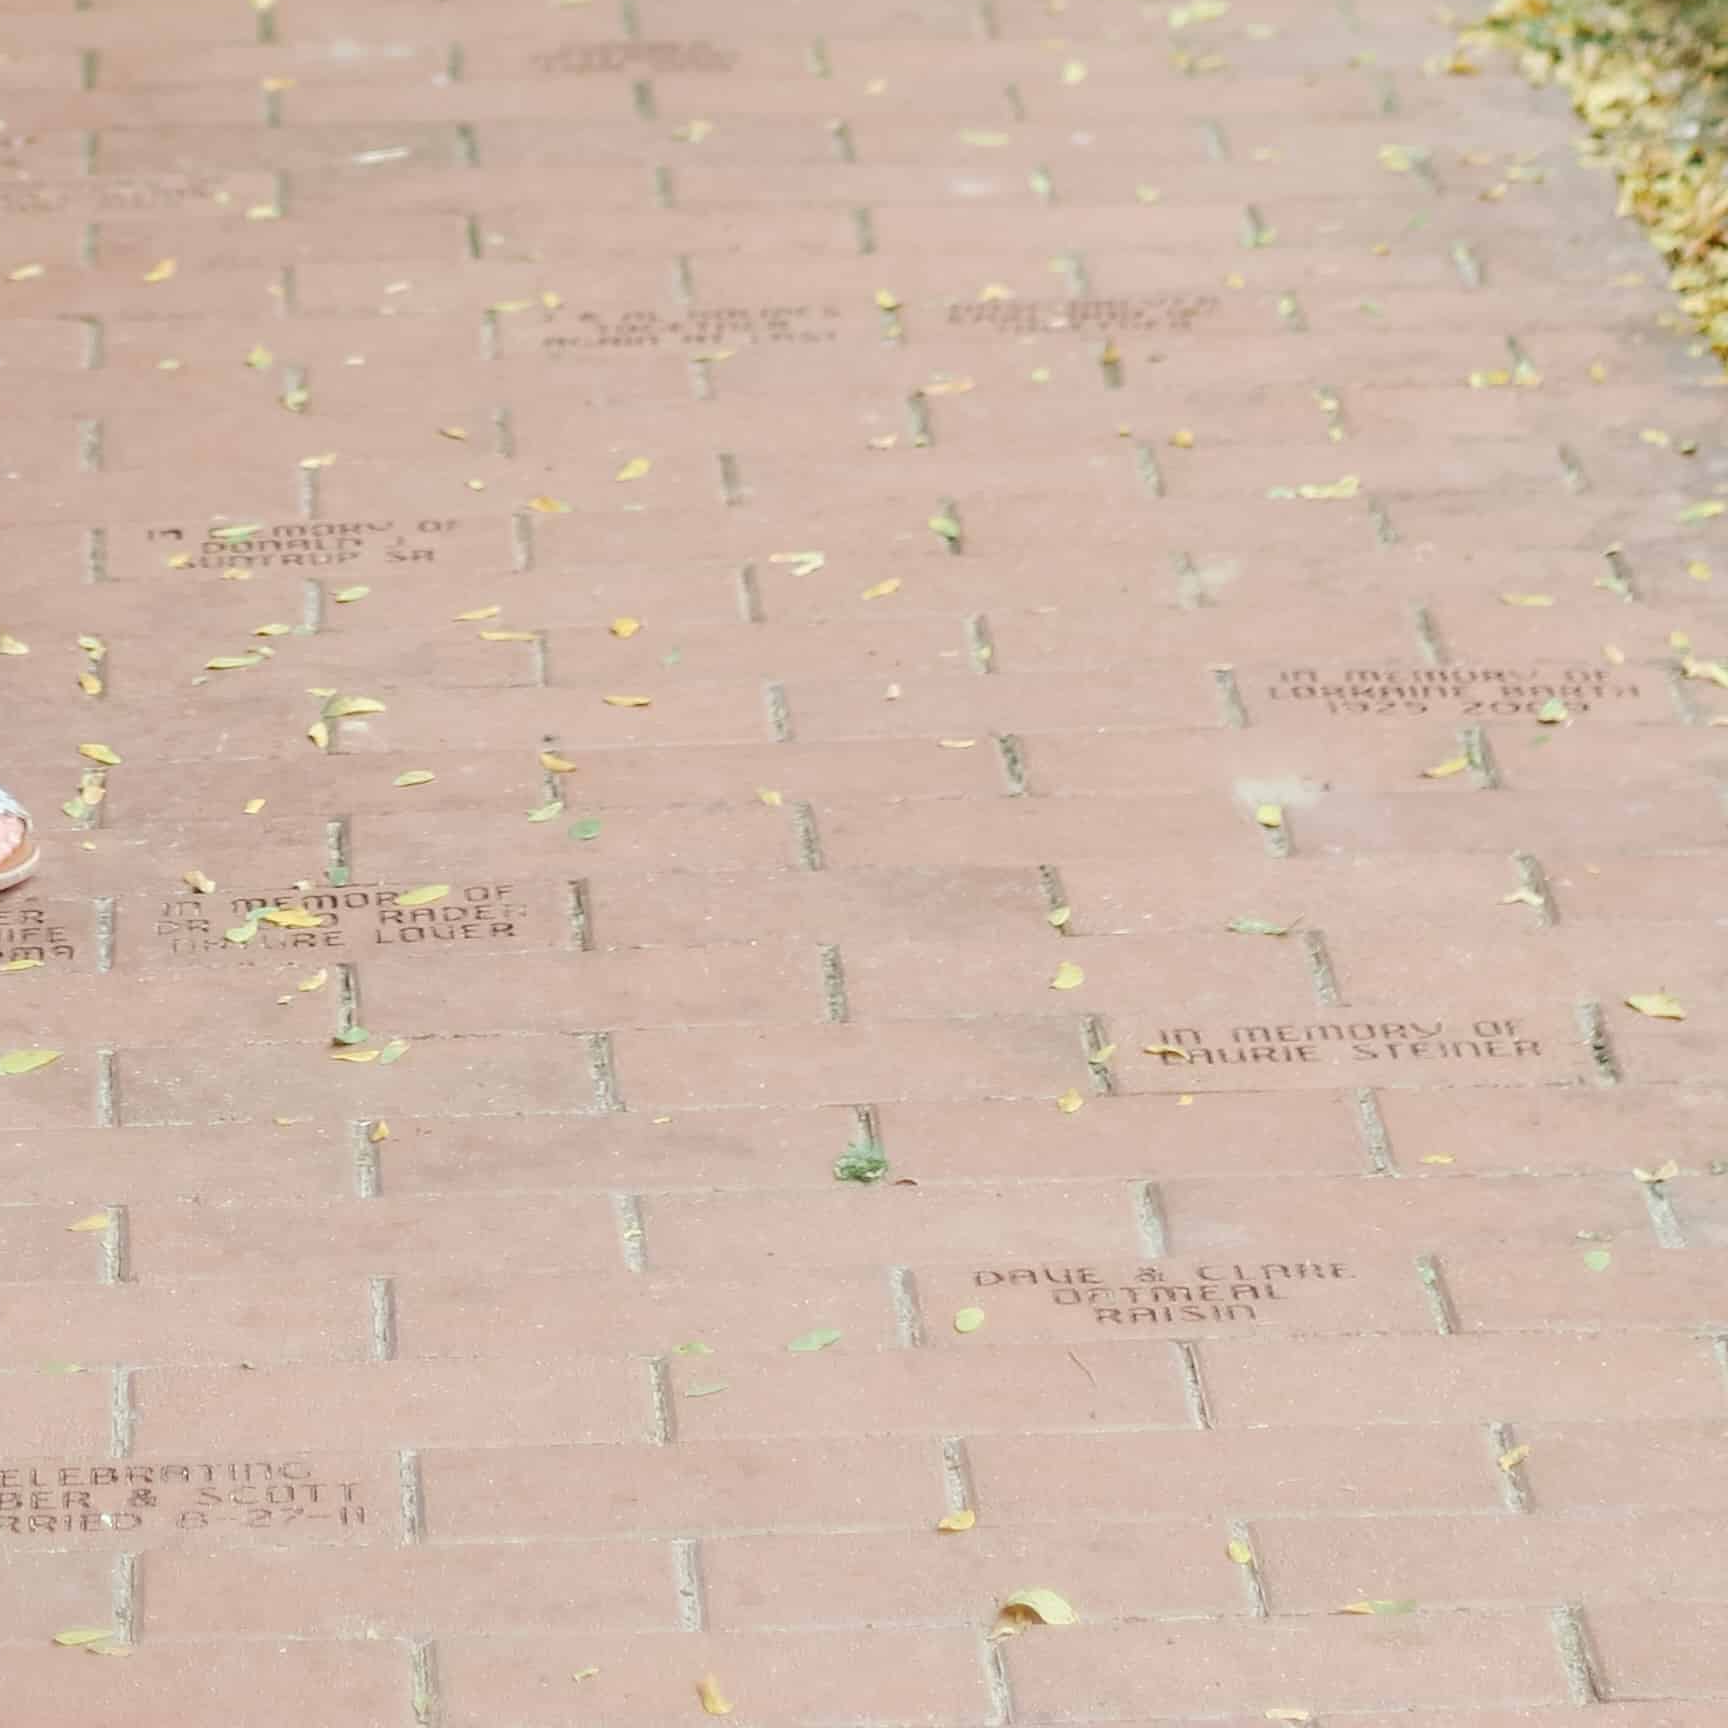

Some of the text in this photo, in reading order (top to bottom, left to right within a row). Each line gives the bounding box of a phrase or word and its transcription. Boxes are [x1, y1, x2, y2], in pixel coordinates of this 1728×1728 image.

[208, 520, 394, 539] MORY
[201, 538, 363, 554] DONALD
[161, 885, 513, 916] IN MEMOR OF
[157, 918, 209, 935] DR
[378, 904, 527, 924] RADER
[173, 930, 345, 953] NAURE
[1159, 1018, 1525, 1045] IN MEMORY OF
[1159, 1040, 1544, 1066] LAURIE STEINER
[1054, 1283, 1288, 1305] OATMEAL
[1096, 1304, 1257, 1325] RAISIN
[129, 1488, 158, 1508] &
[196, 1482, 362, 1506] SCOTT
